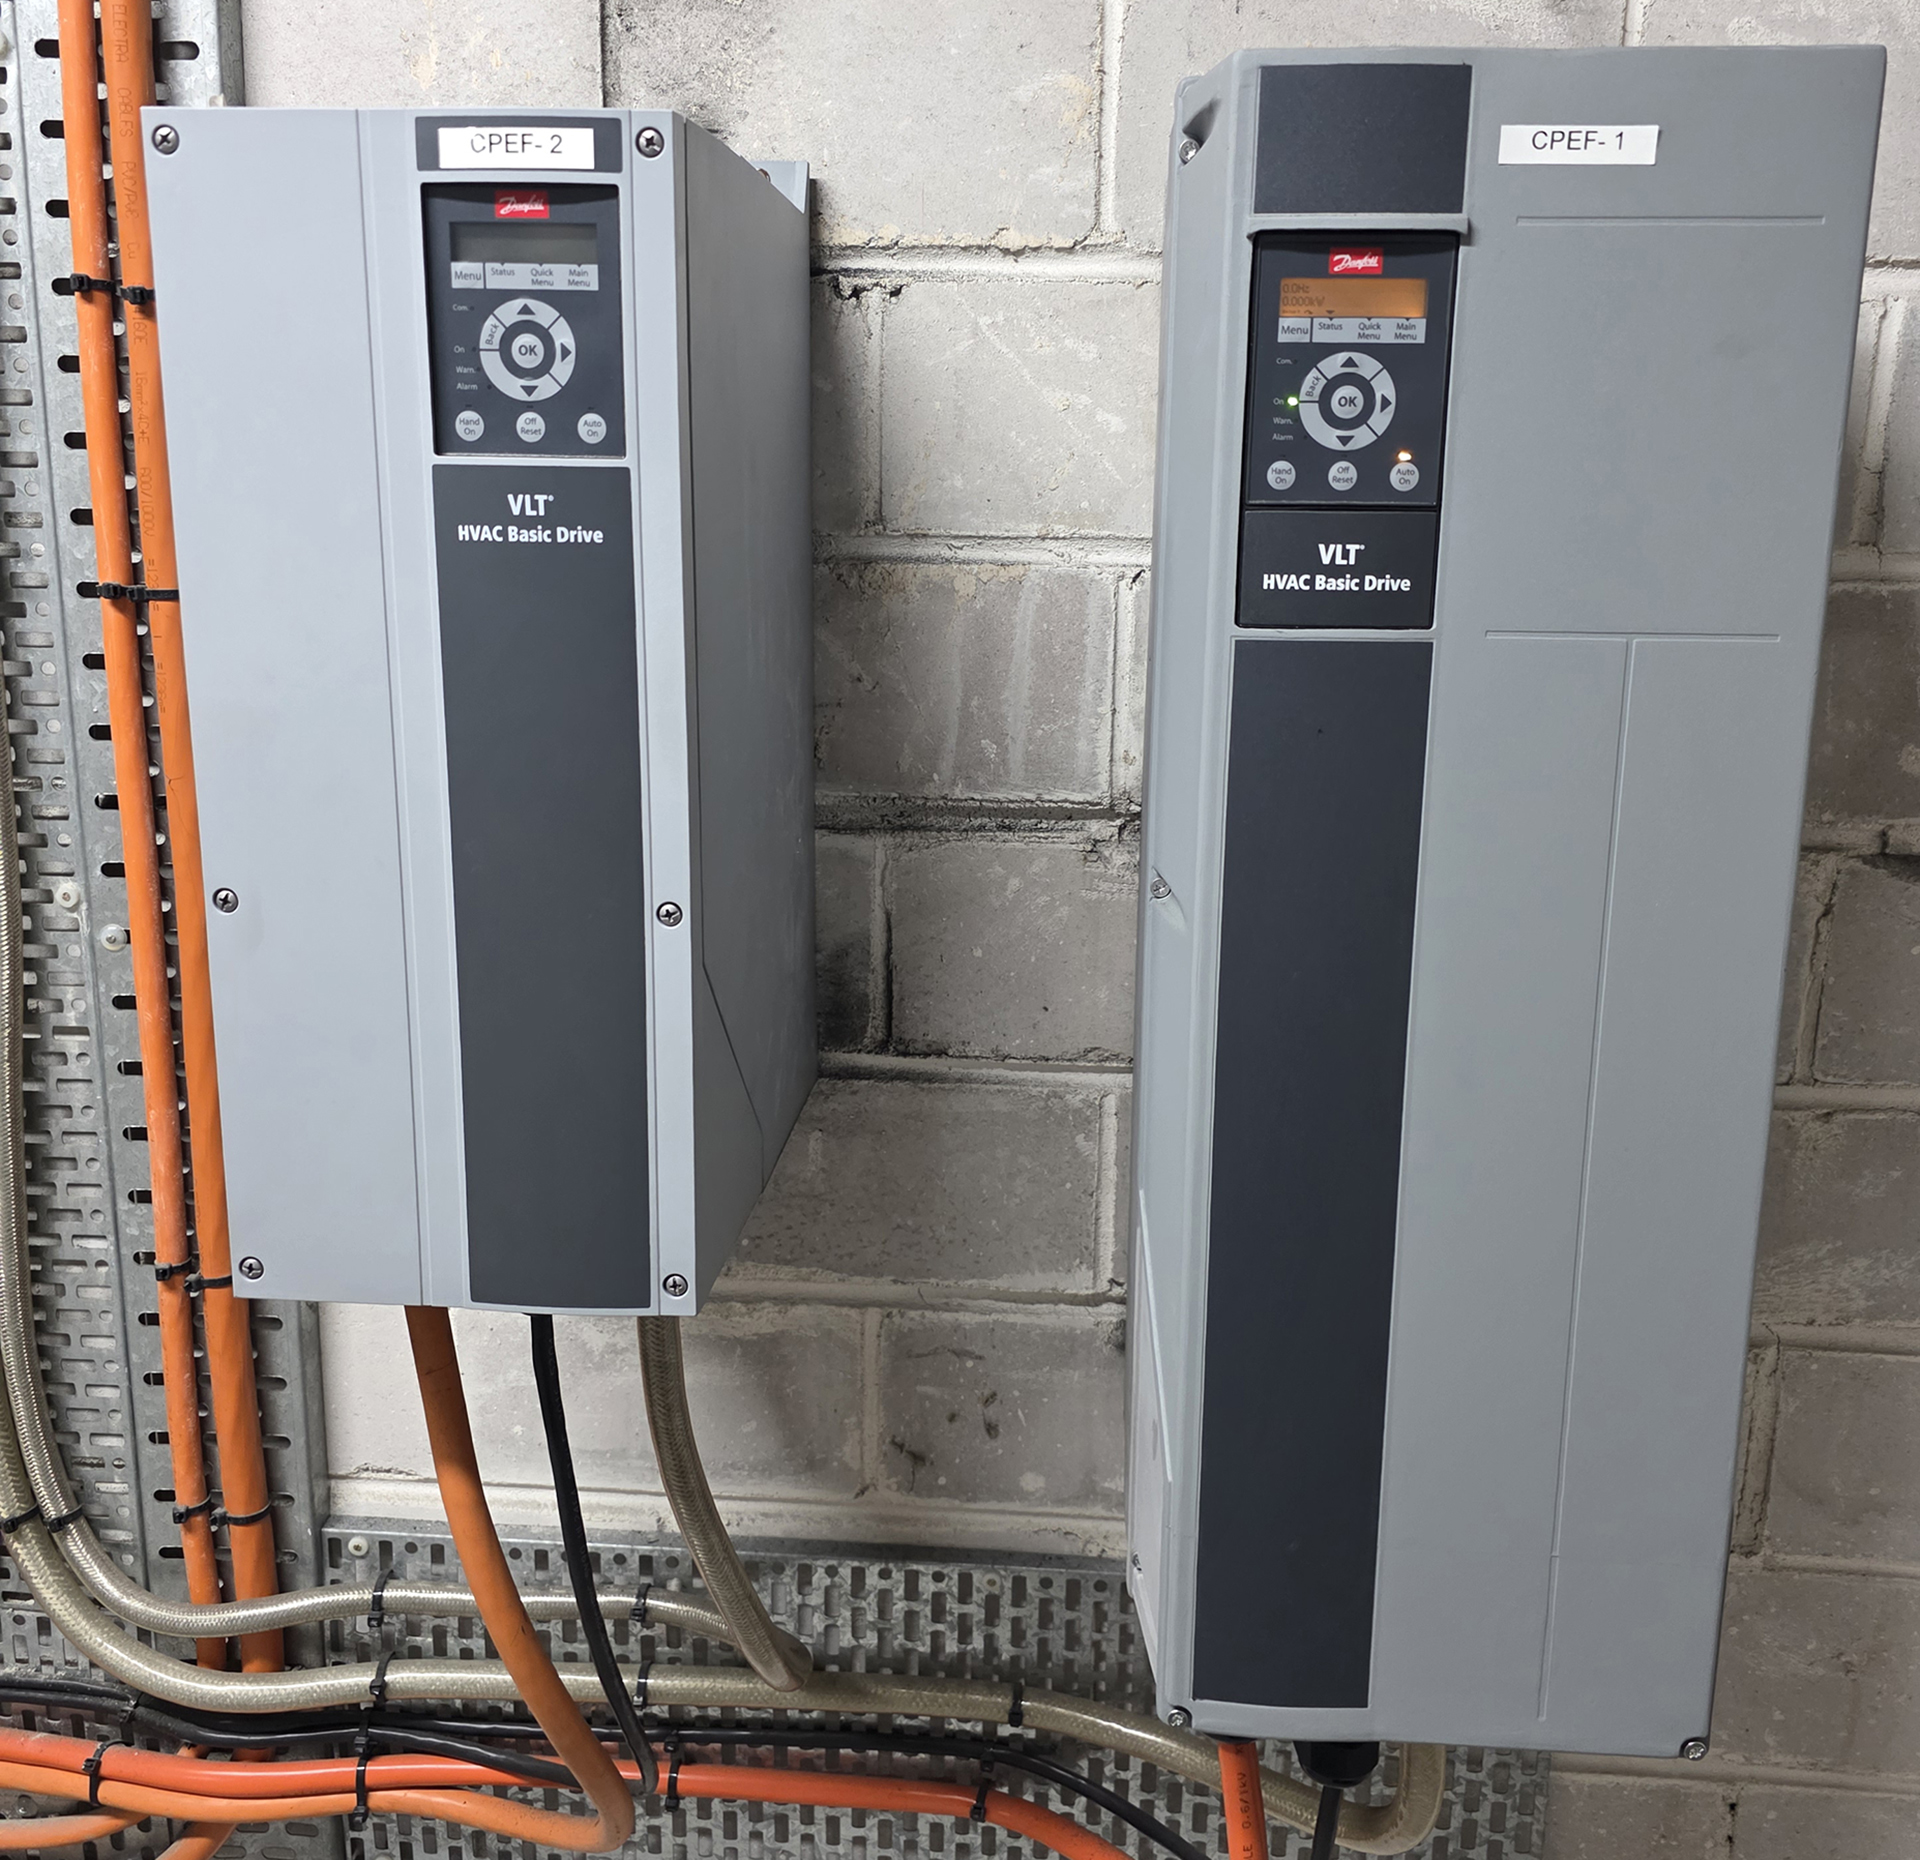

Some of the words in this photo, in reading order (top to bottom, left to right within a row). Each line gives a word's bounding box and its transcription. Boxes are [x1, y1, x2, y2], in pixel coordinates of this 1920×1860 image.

[113, 3, 129, 63] ELECTRA
[117, 87, 134, 138] CABLES
[471, 133, 542, 153] CPEF-
[550, 134, 562, 154] 2
[1532, 131, 1605, 150] CPEF-
[1616, 131, 1624, 150] 1
[1333, 252, 1378, 271] Danfoss
[455, 271, 481, 281] Menu
[491, 268, 515, 276] Status
[531, 268, 553, 277] Quick
[569, 269, 588, 277] Main
[568, 279, 590, 287] Menu
[1281, 326, 1309, 335] Menu
[1318, 322, 1343, 330] Status
[1358, 322, 1381, 331] Quick
[485, 323, 499, 345] Back
[454, 345, 465, 353] On
[518, 345, 538, 356] OK
[1305, 375, 1321, 397] Back
[1338, 396, 1358, 407] OK
[459, 418, 480, 426] Hand
[583, 420, 602, 428] Auto
[521, 427, 542, 435] Reset
[1332, 476, 1353, 484] Reset
[1399, 477, 1411, 485] On
[458, 525, 503, 541] HVAC
[508, 525, 552, 542] Basic
[556, 525, 604, 543] Drive
[1263, 574, 1310, 590] HVAC
[1315, 574, 1360, 591] Basic
[1364, 574, 1411, 591] Drive
